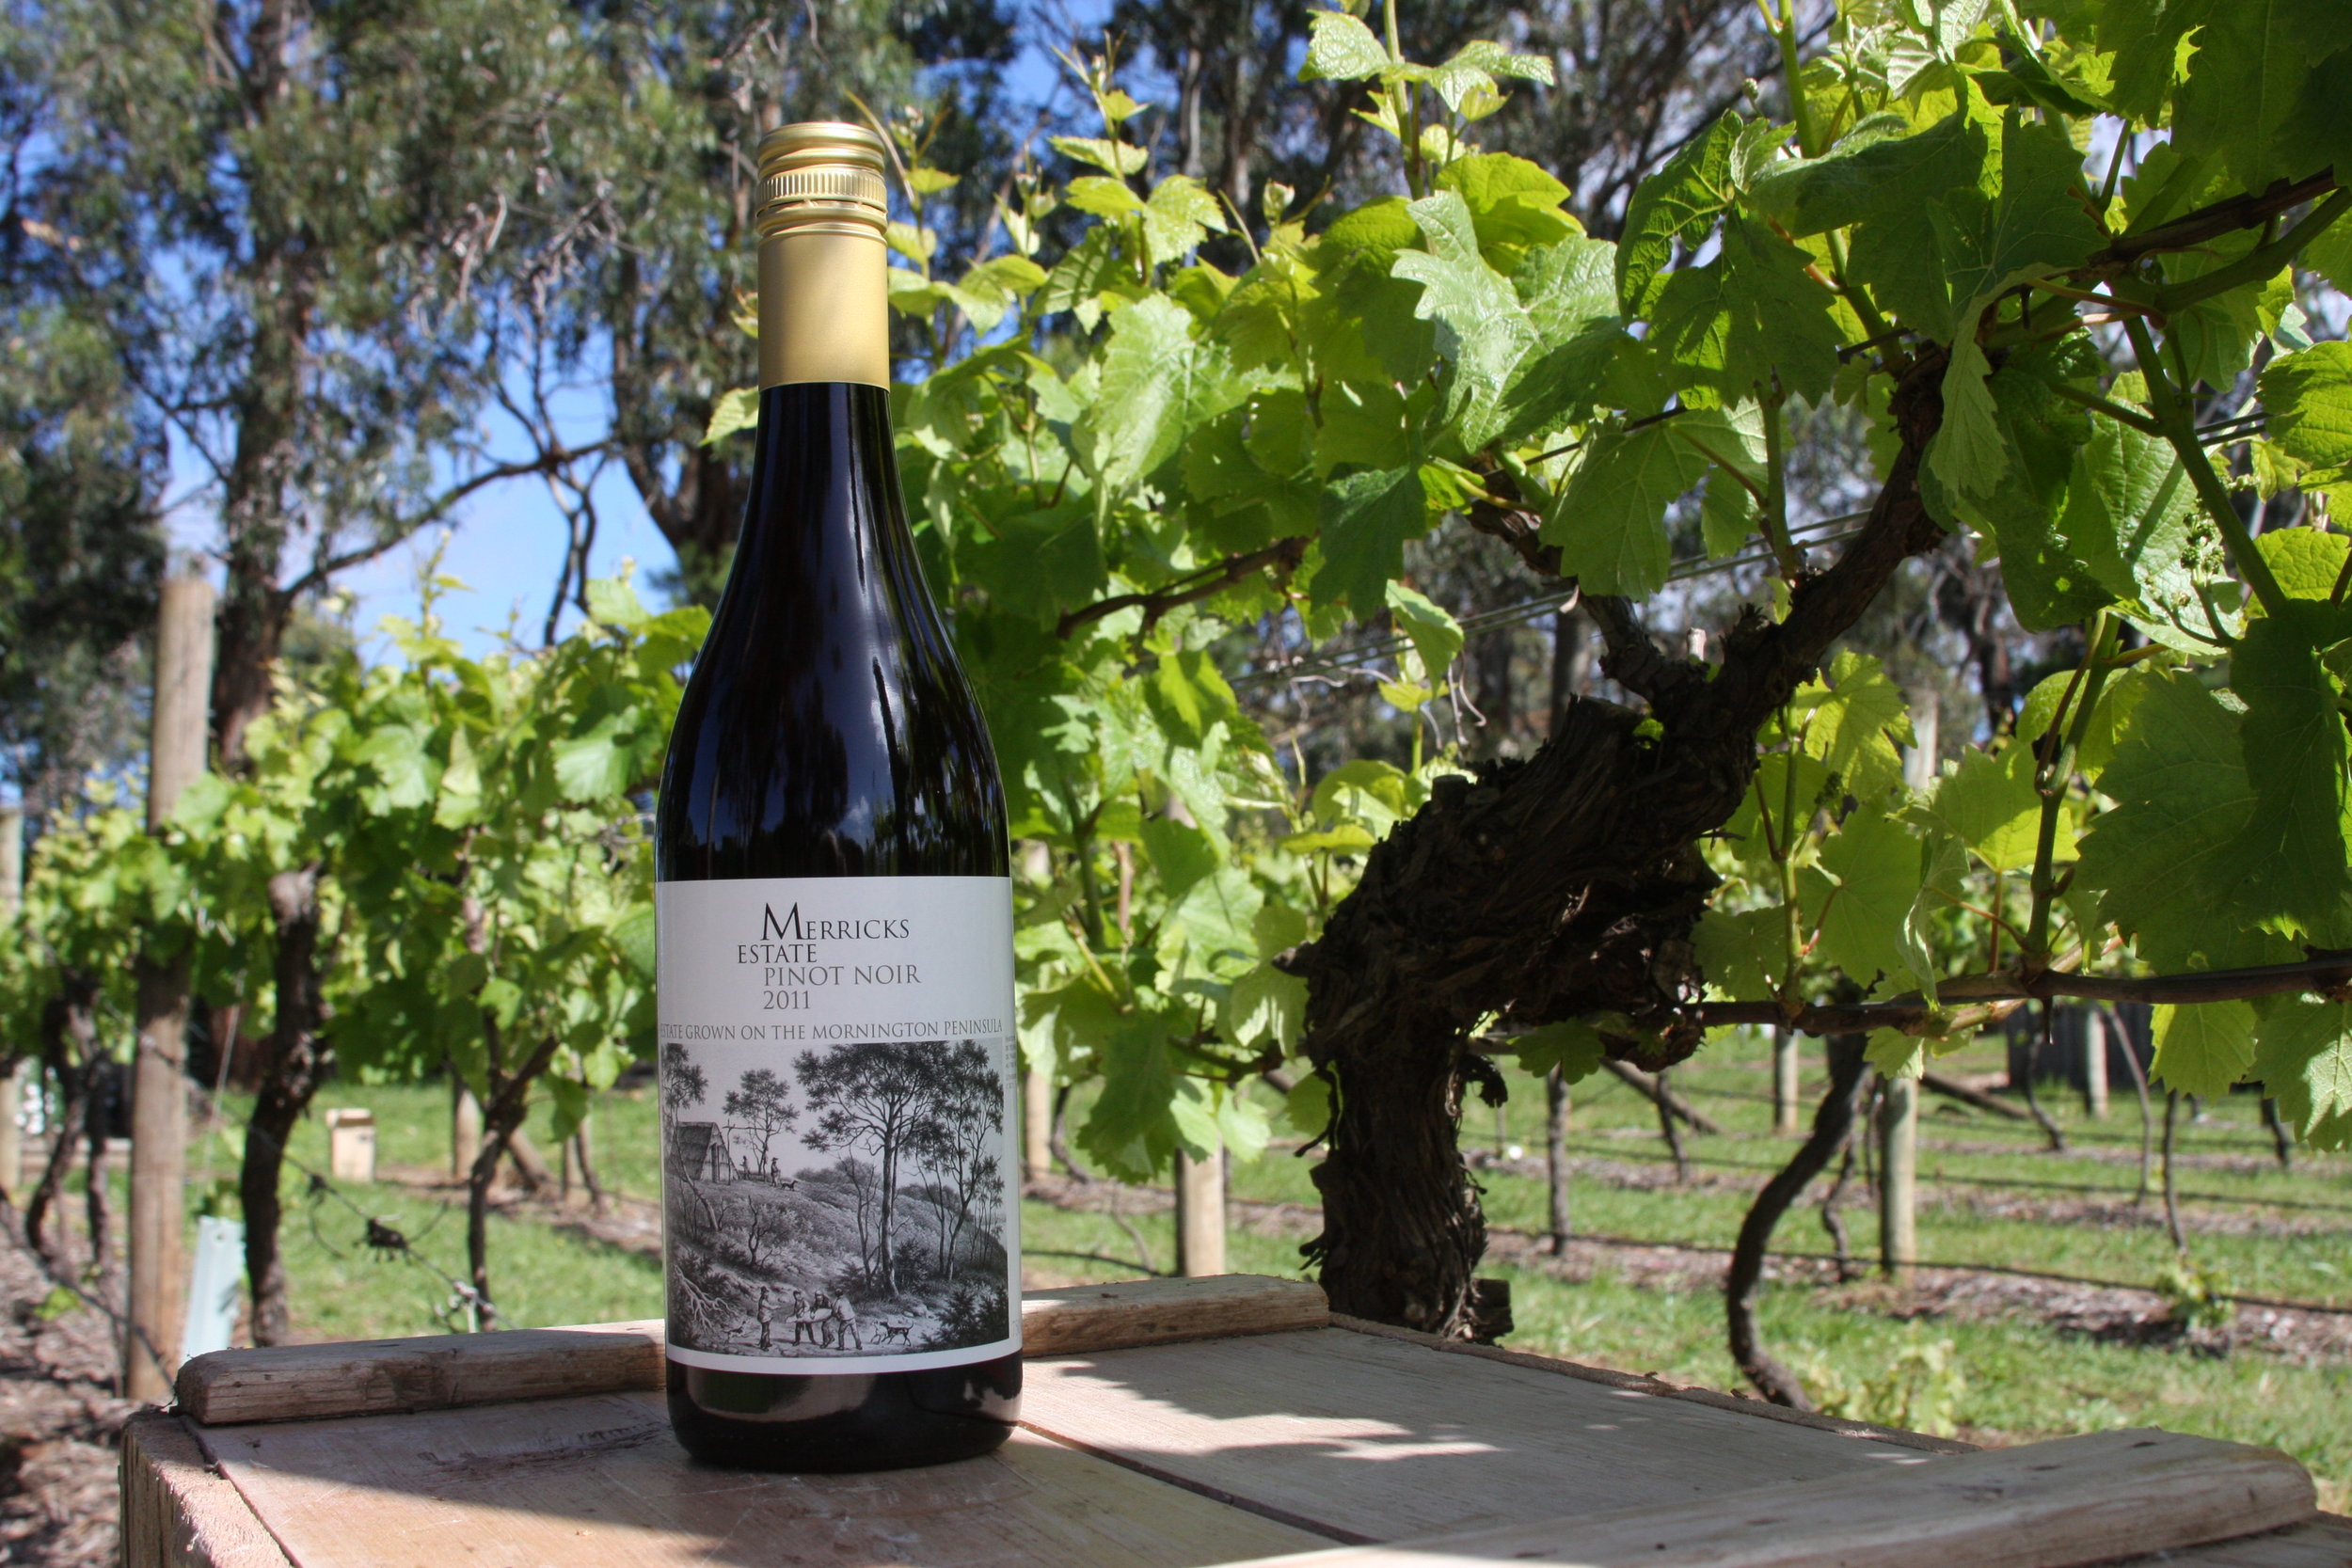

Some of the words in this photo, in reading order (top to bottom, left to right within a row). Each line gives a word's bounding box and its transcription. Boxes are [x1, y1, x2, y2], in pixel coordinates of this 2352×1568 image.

[760, 901, 910, 941] MERRICKS
[738, 943, 818, 964] ESTATE
[764, 966, 844, 987] PINOT
[854, 964, 922, 985] NOIR
[763, 990, 811, 1010] 2011
[685, 1024, 736, 1039] GROWN
[740, 1024, 767, 1040] ON
[771, 1024, 806, 1040] THE
[812, 1022, 939, 1040] MORNINGTON
[944, 1018, 1003, 1036] PENINSULA
